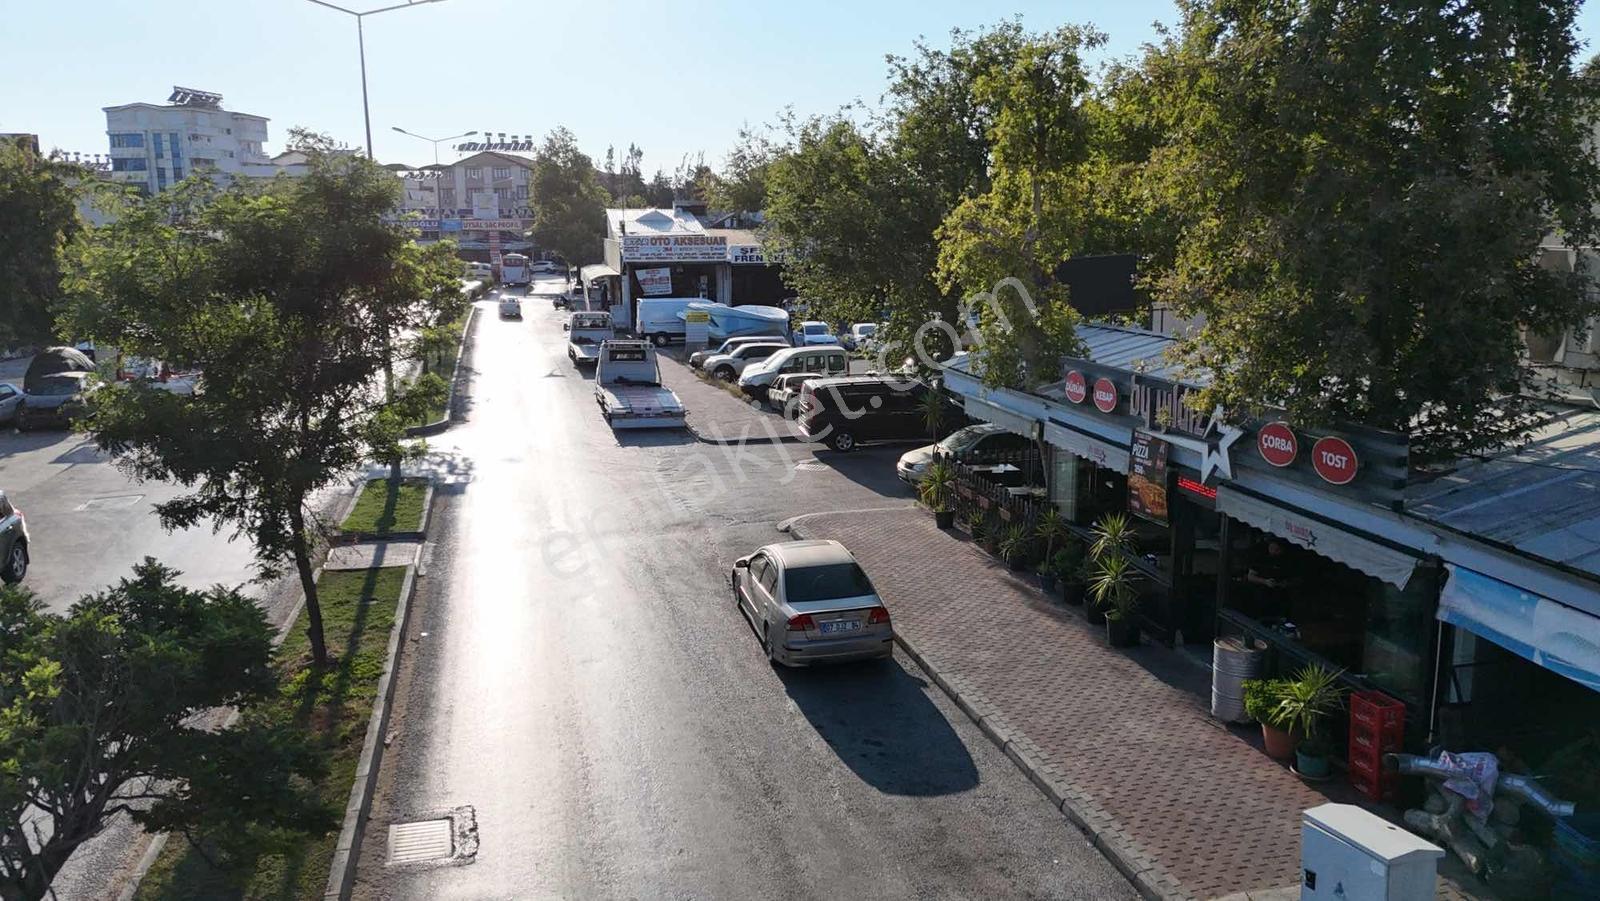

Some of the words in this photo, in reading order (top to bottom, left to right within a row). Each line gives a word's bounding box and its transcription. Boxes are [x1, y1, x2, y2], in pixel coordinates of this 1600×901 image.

[650, 236, 670, 246] OTO
[673, 236, 727, 246] AKSESUAR
[734, 254, 764, 262] FREN
[1096, 391, 1114, 402] KEBAP
[1262, 433, 1293, 453] ÇORBA
[1321, 451, 1348, 470] TOST
